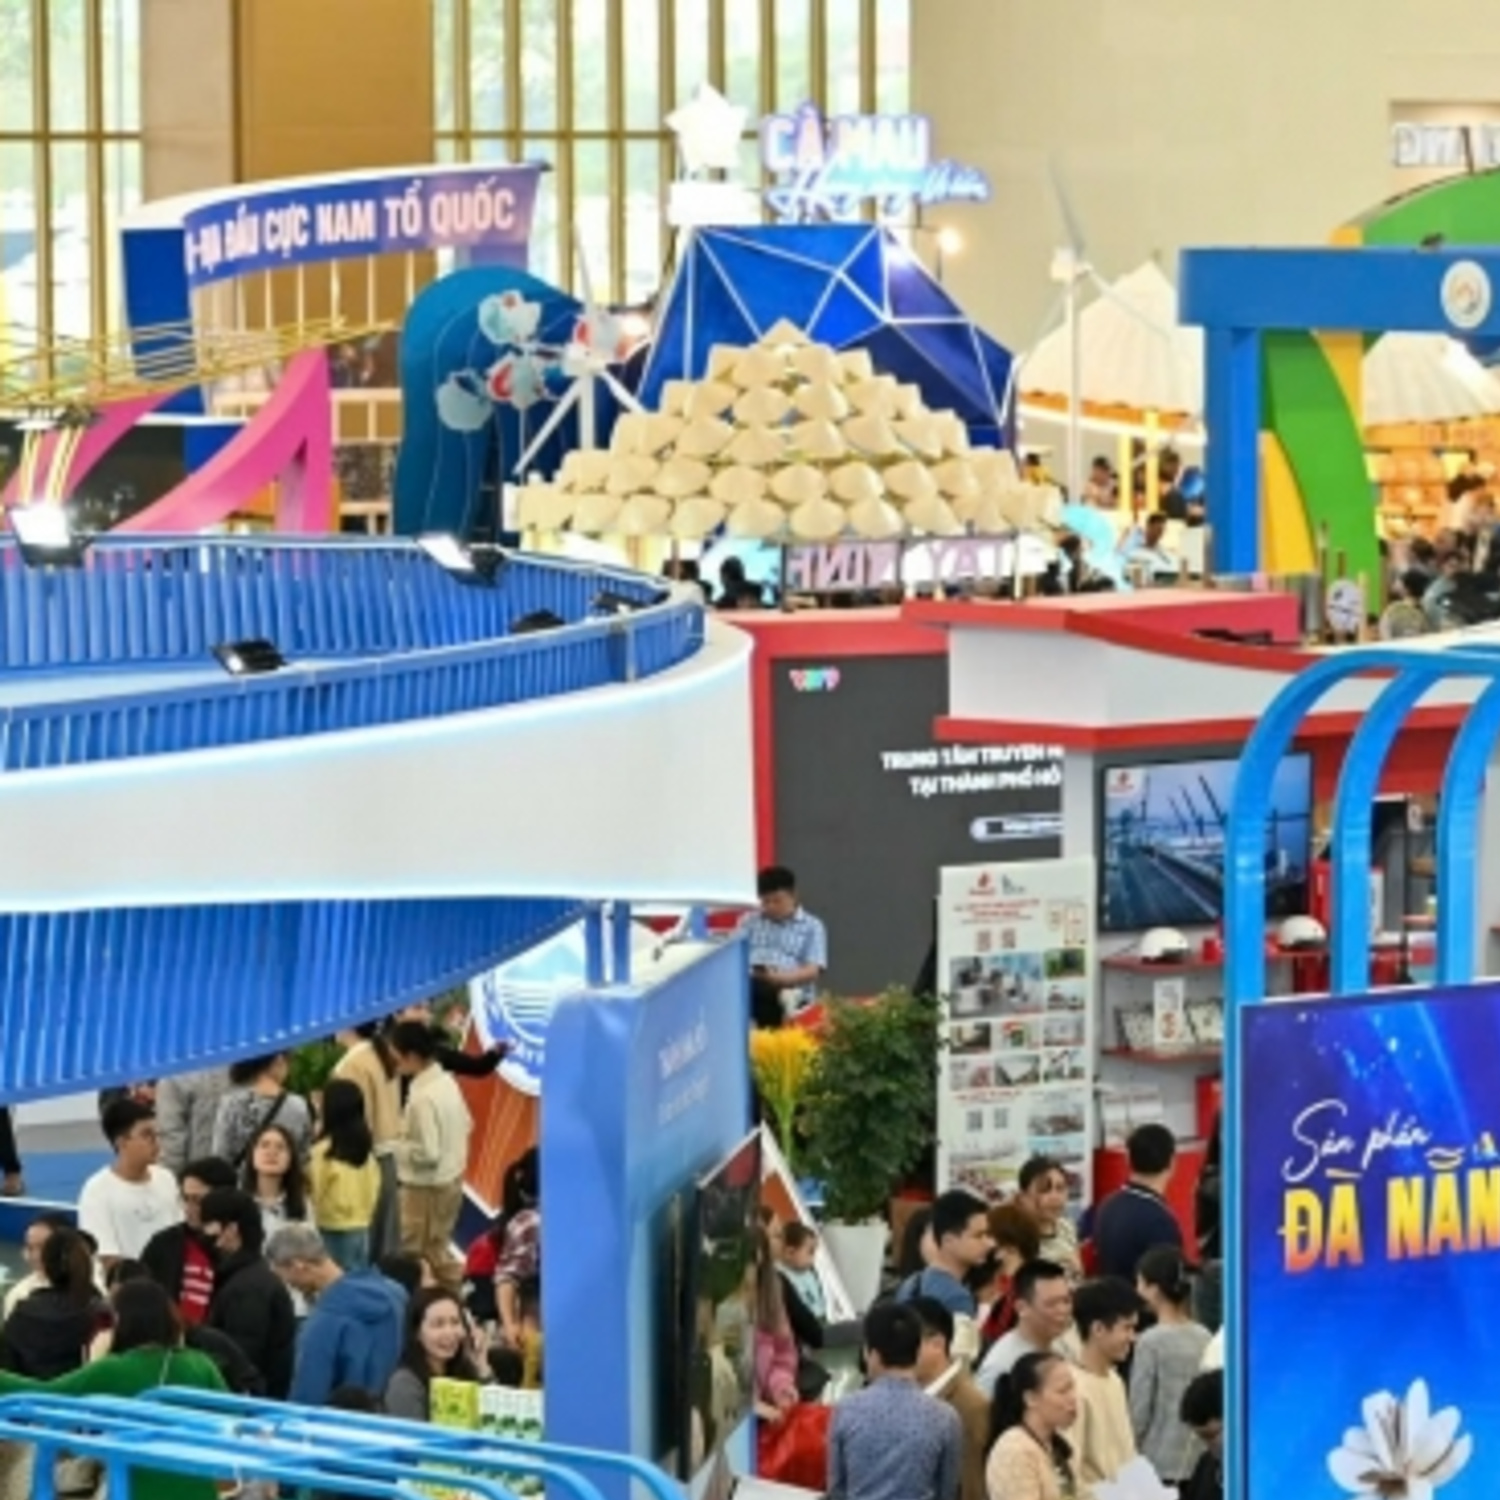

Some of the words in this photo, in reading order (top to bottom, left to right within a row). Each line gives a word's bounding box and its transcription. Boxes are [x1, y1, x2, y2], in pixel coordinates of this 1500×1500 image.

[315, 199, 377, 245] NAM
[384, 179, 422, 238] TỔ
[428, 175, 516, 237] QUỐC
[1281, 1098, 1354, 1183] Sản
[1277, 1168, 1364, 1273] ĐÀ
